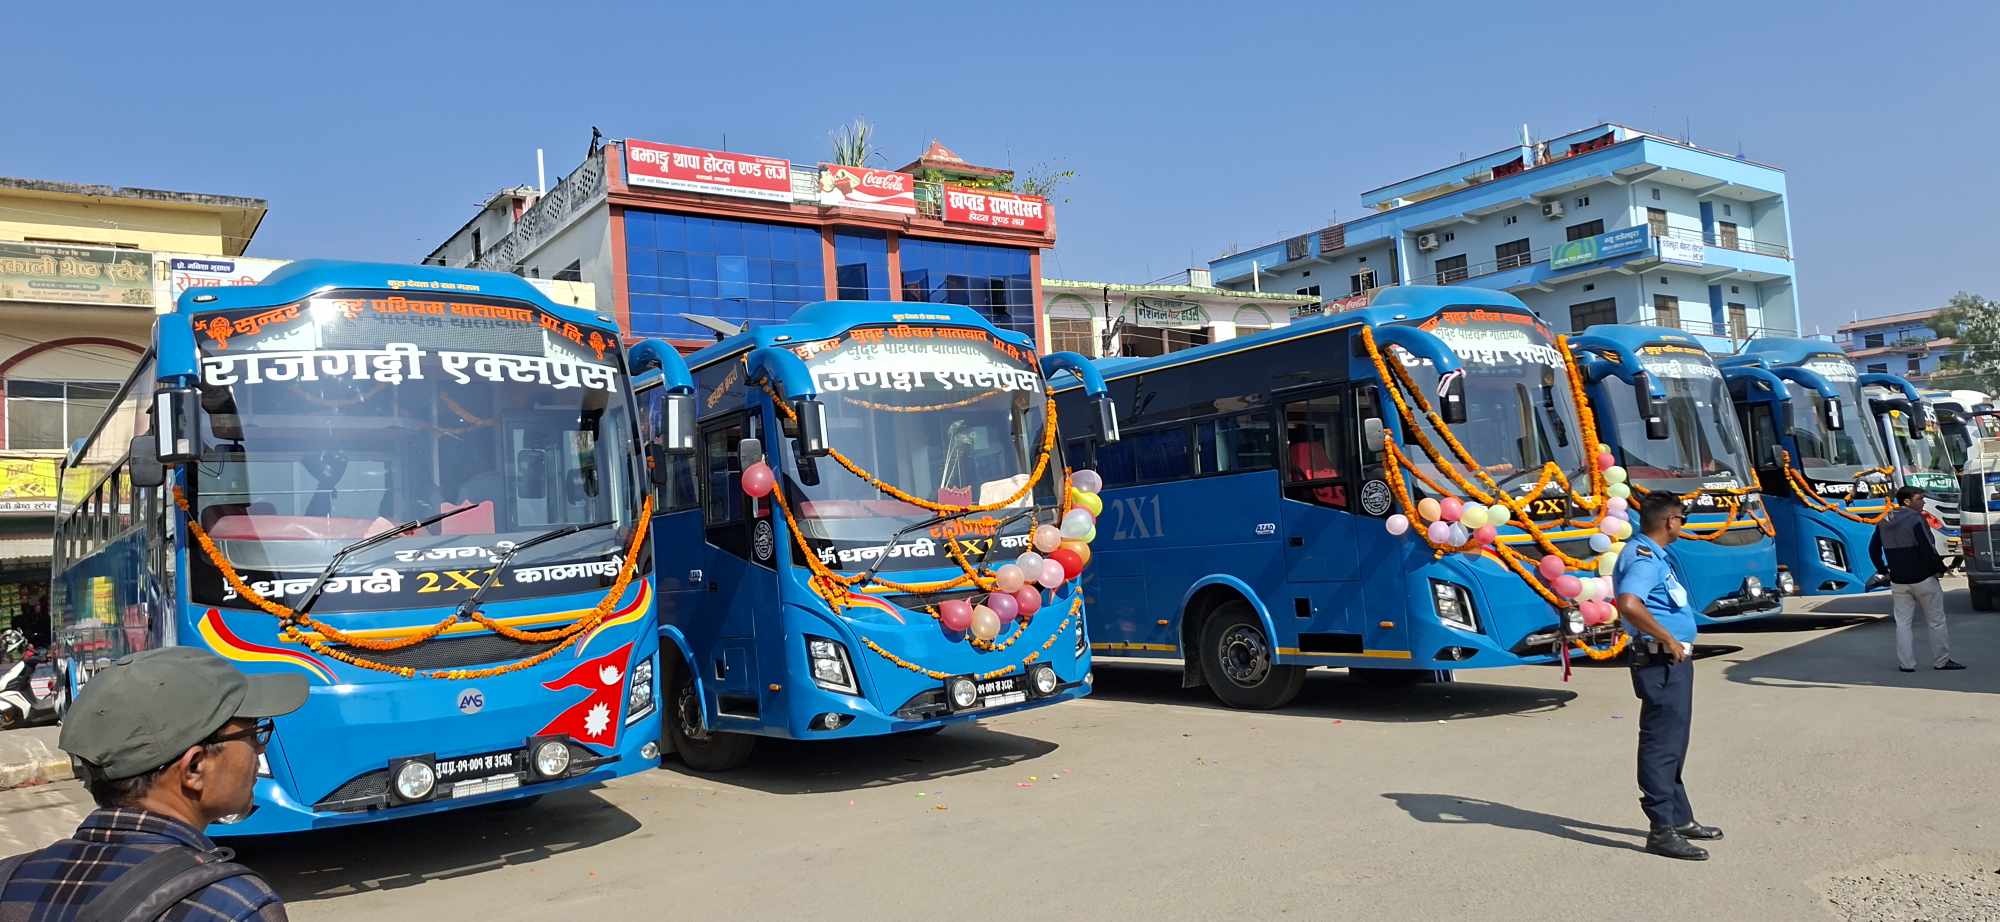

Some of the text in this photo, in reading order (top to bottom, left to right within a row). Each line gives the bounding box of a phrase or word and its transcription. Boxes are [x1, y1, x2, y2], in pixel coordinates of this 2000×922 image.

[673, 153, 700, 169] थापा
[703, 153, 735, 174] होटल
[738, 161, 761, 177] एण्ड
[764, 165, 787, 179] लज
[948, 191, 985, 211] खप्तड
[988, 195, 1042, 219] रामारोसन
[0, 255, 56, 276] काली
[234, 304, 300, 335] सुन्दर
[372, 297, 446, 317] पश्चिम
[449, 303, 533, 322] यातायात
[938, 328, 987, 341] यातायात
[438, 349, 618, 392] एक्सप्रेस
[1112, 494, 1165, 540] 2X1
[250, 568, 404, 598] धनगढी
[416, 569, 504, 593] 2X1
